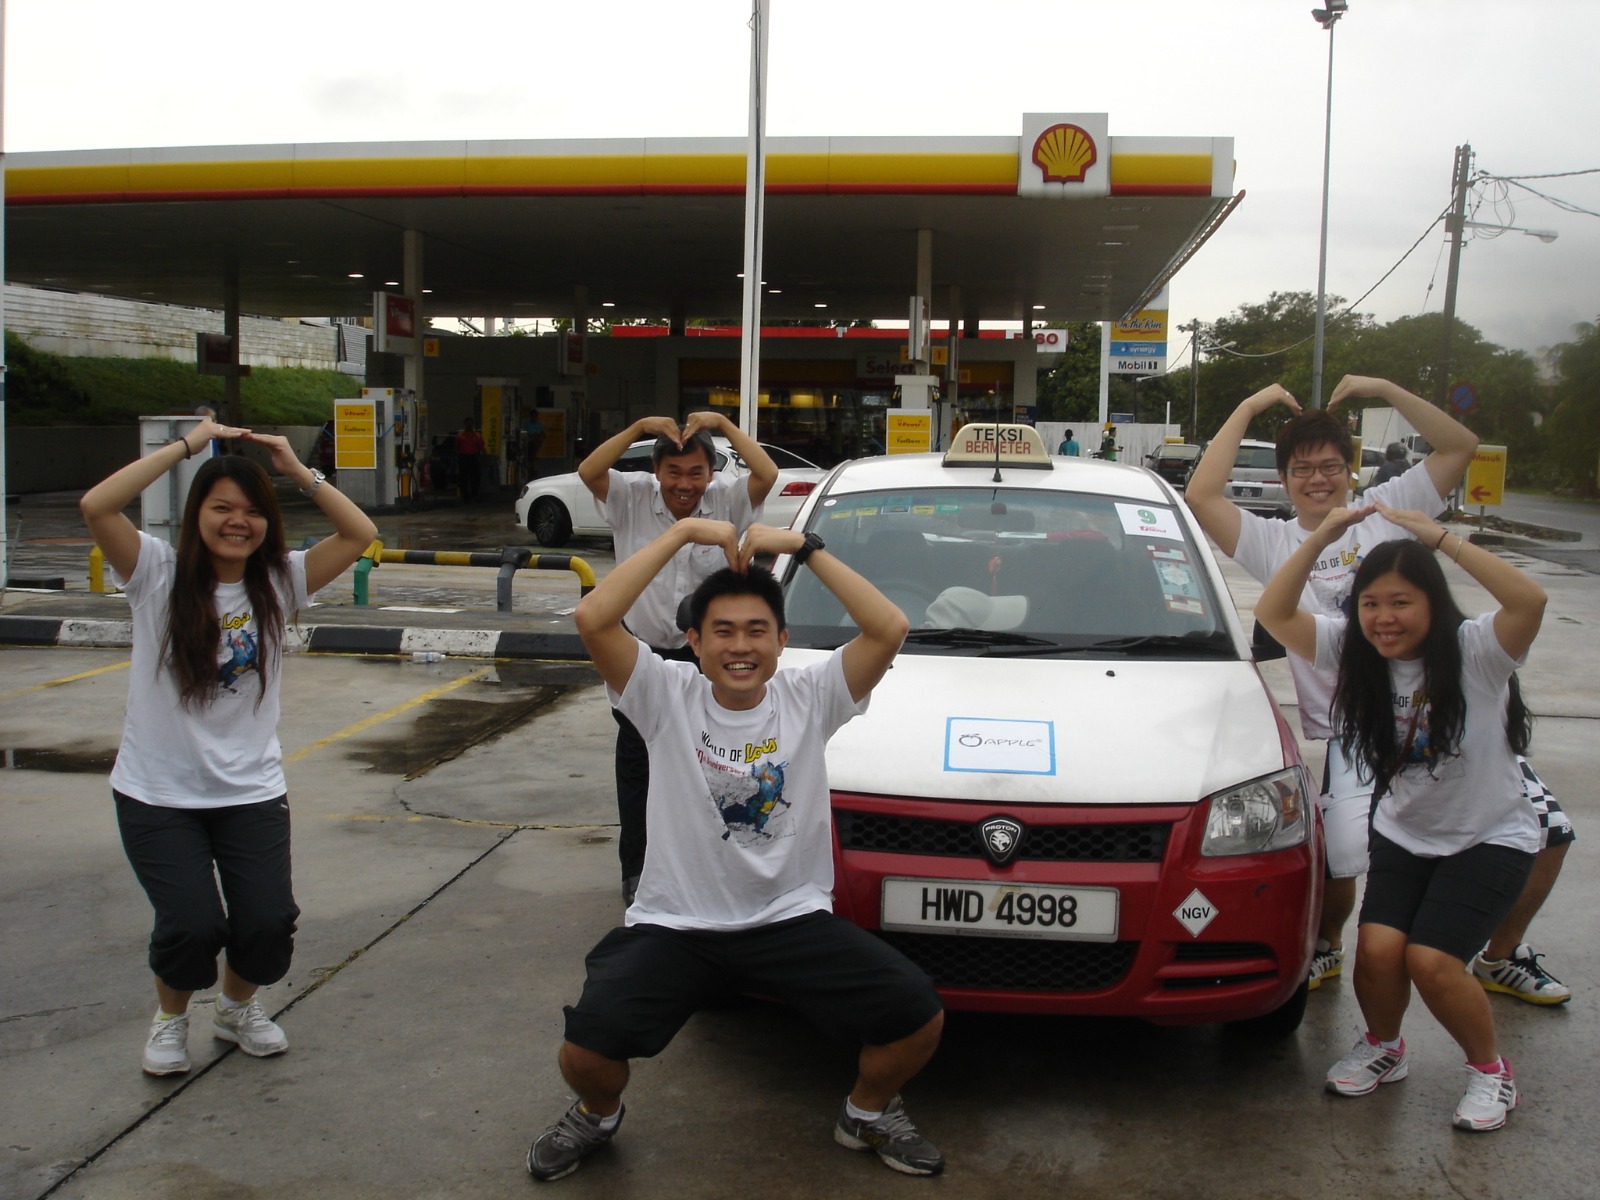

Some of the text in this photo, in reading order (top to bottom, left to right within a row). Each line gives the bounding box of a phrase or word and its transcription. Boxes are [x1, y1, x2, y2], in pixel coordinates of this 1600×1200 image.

[1143, 319, 1162, 329] Run
[1118, 361, 1147, 370] Mobil
[973, 428, 1023, 441] TEKSI
[966, 441, 1031, 454] BERMETER
[1137, 509, 1157, 525] 9
[1329, 557, 1340, 569] OF
[730, 749, 742, 762] OF
[985, 824, 1018, 833] PROTON
[921, 887, 1078, 928] HWD 4998
[1181, 906, 1211, 920] NGV
